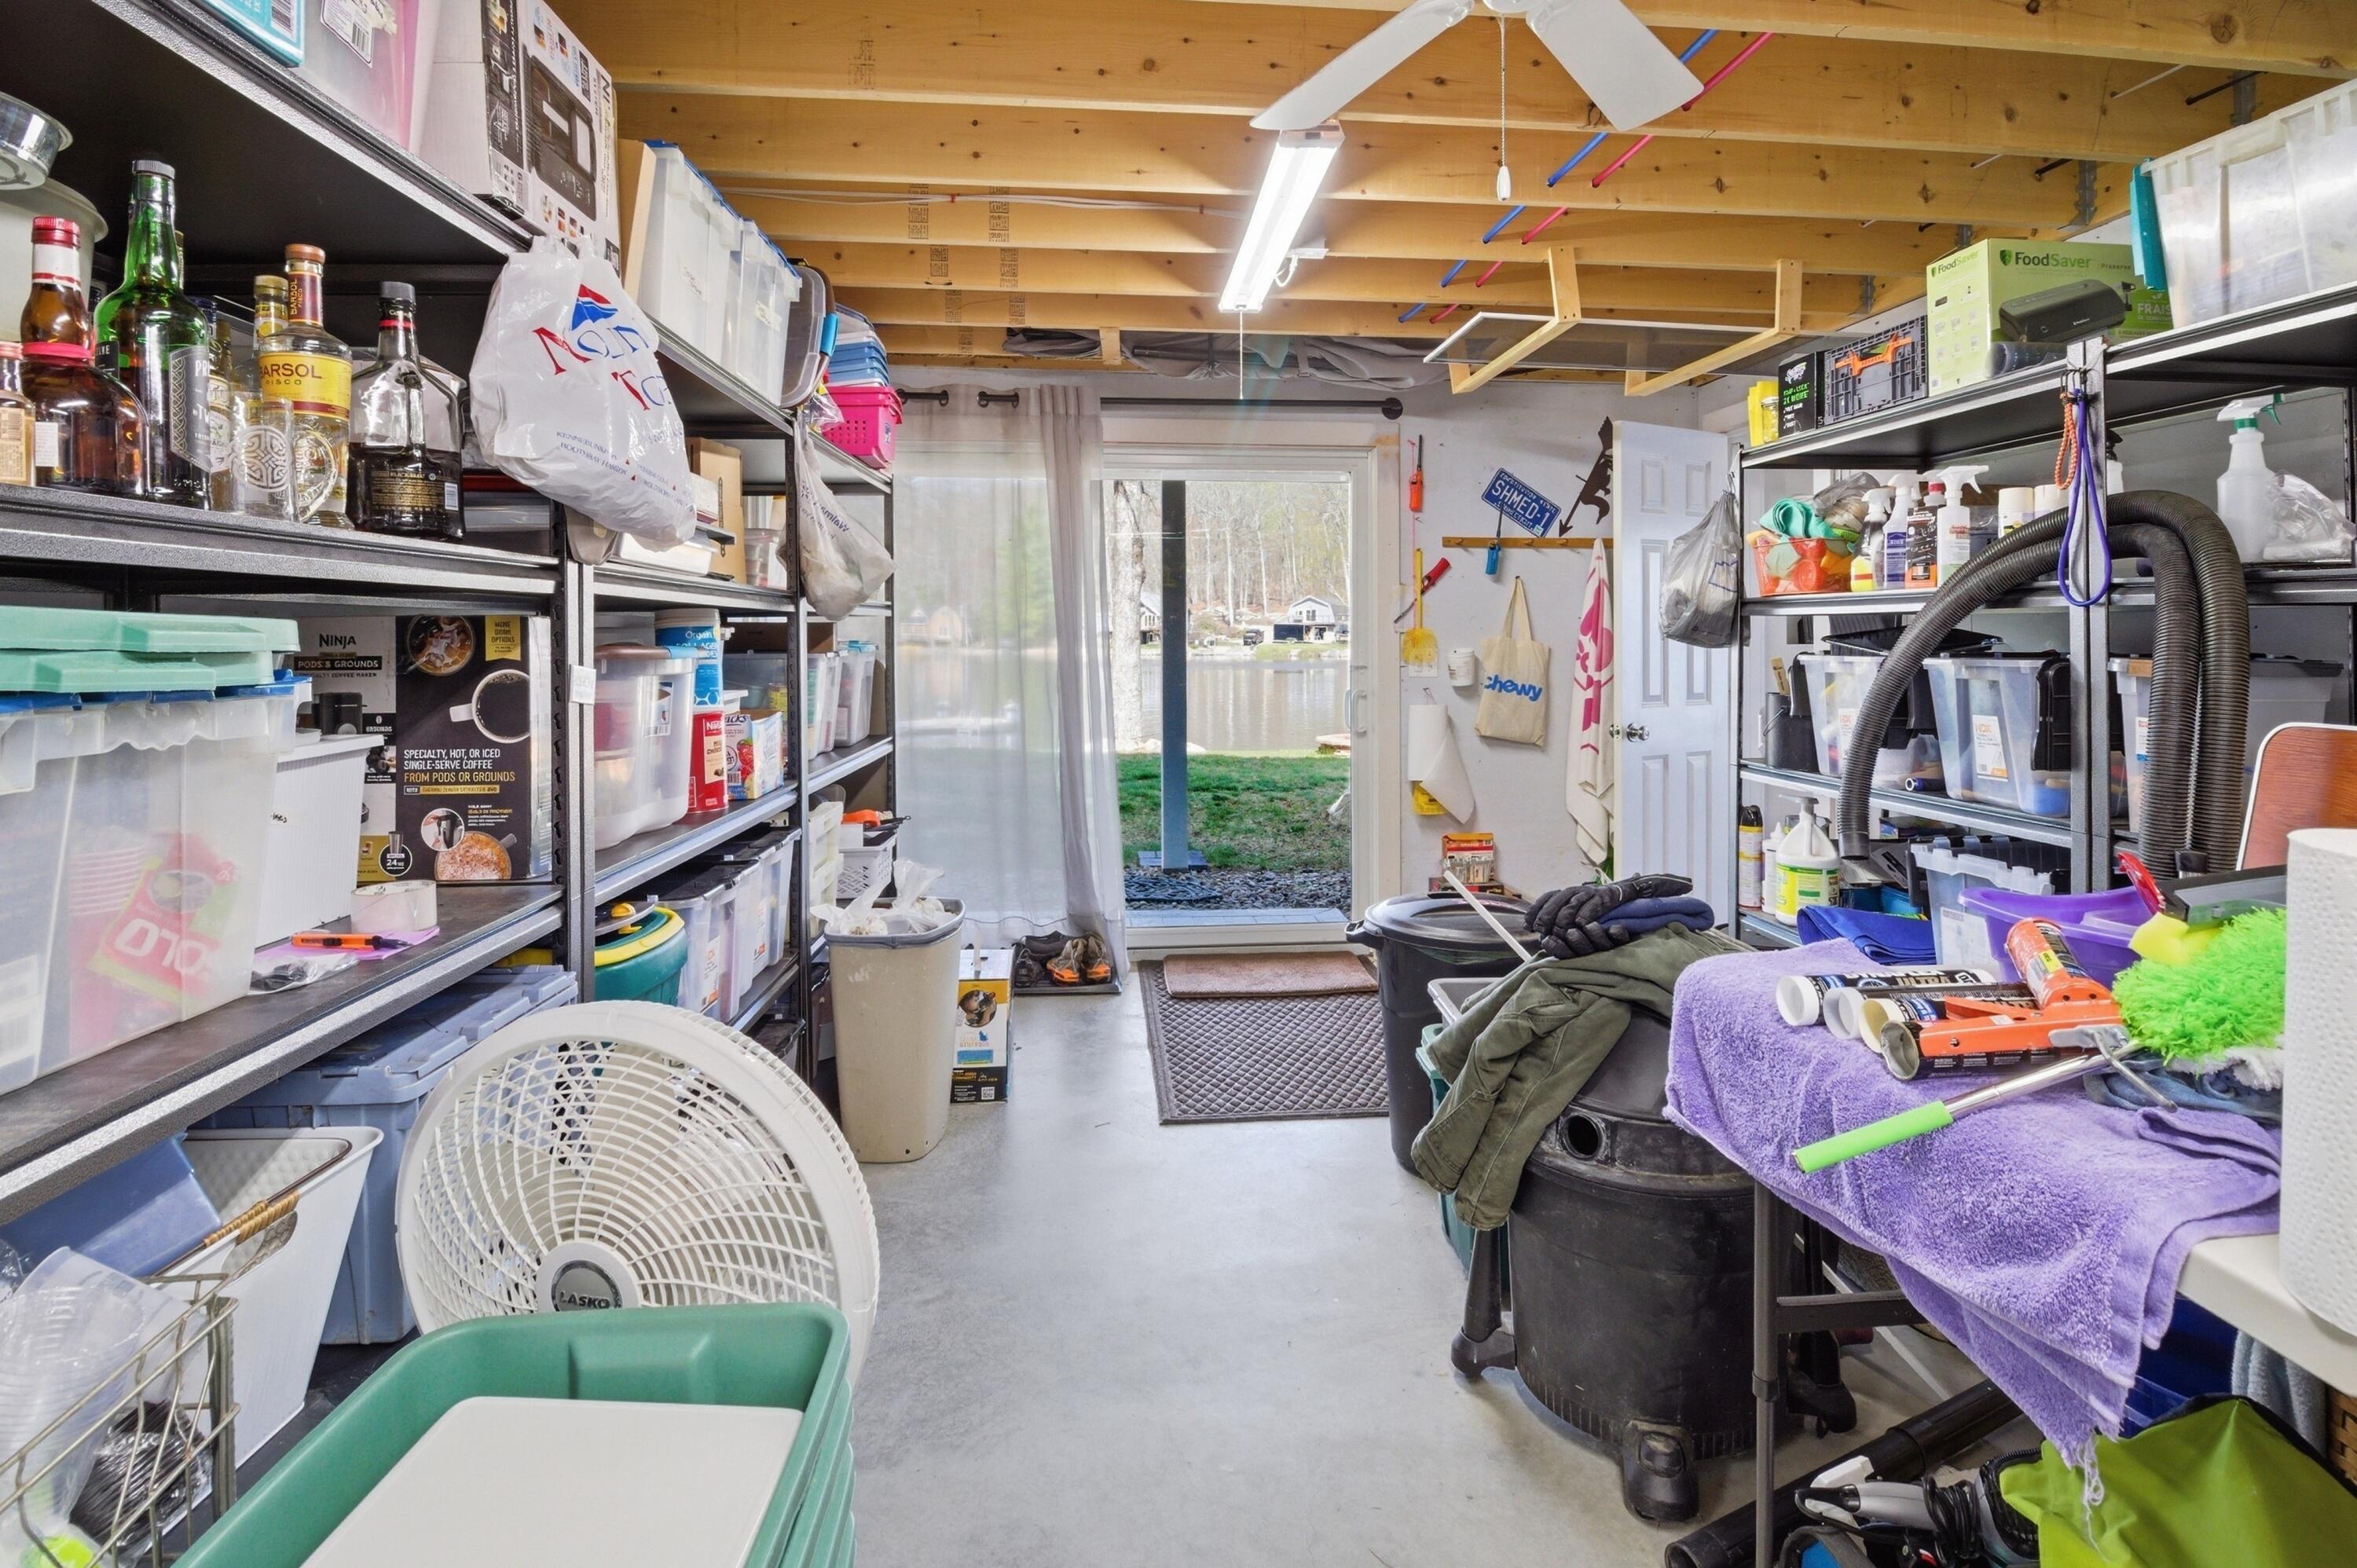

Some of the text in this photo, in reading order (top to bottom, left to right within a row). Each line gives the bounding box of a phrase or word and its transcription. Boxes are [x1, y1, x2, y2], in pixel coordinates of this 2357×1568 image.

[1937, 250, 1978, 273] FoodSaver
[2014, 251, 2091, 269] FoodSaver
[1491, 479, 1550, 527] SHMED-1
[319, 633, 357, 649] NINJA
[685, 630, 713, 639] Orgain
[334, 660, 379, 669] GROUNDS
[1484, 674, 1543, 702] chewy
[404, 749, 501, 760] SPECIALTY, HOT, OR ICED
[404, 760, 493, 770] SINGLE-SERVE COFFEE
[404, 773, 430, 782] FROM
[432, 772, 456, 782] PODS
[458, 772, 471, 782] OR
[473, 771, 516, 782] GROUNDS
[1896, 976, 1950, 987] ULTRA
[559, 1291, 610, 1310] LASKO
